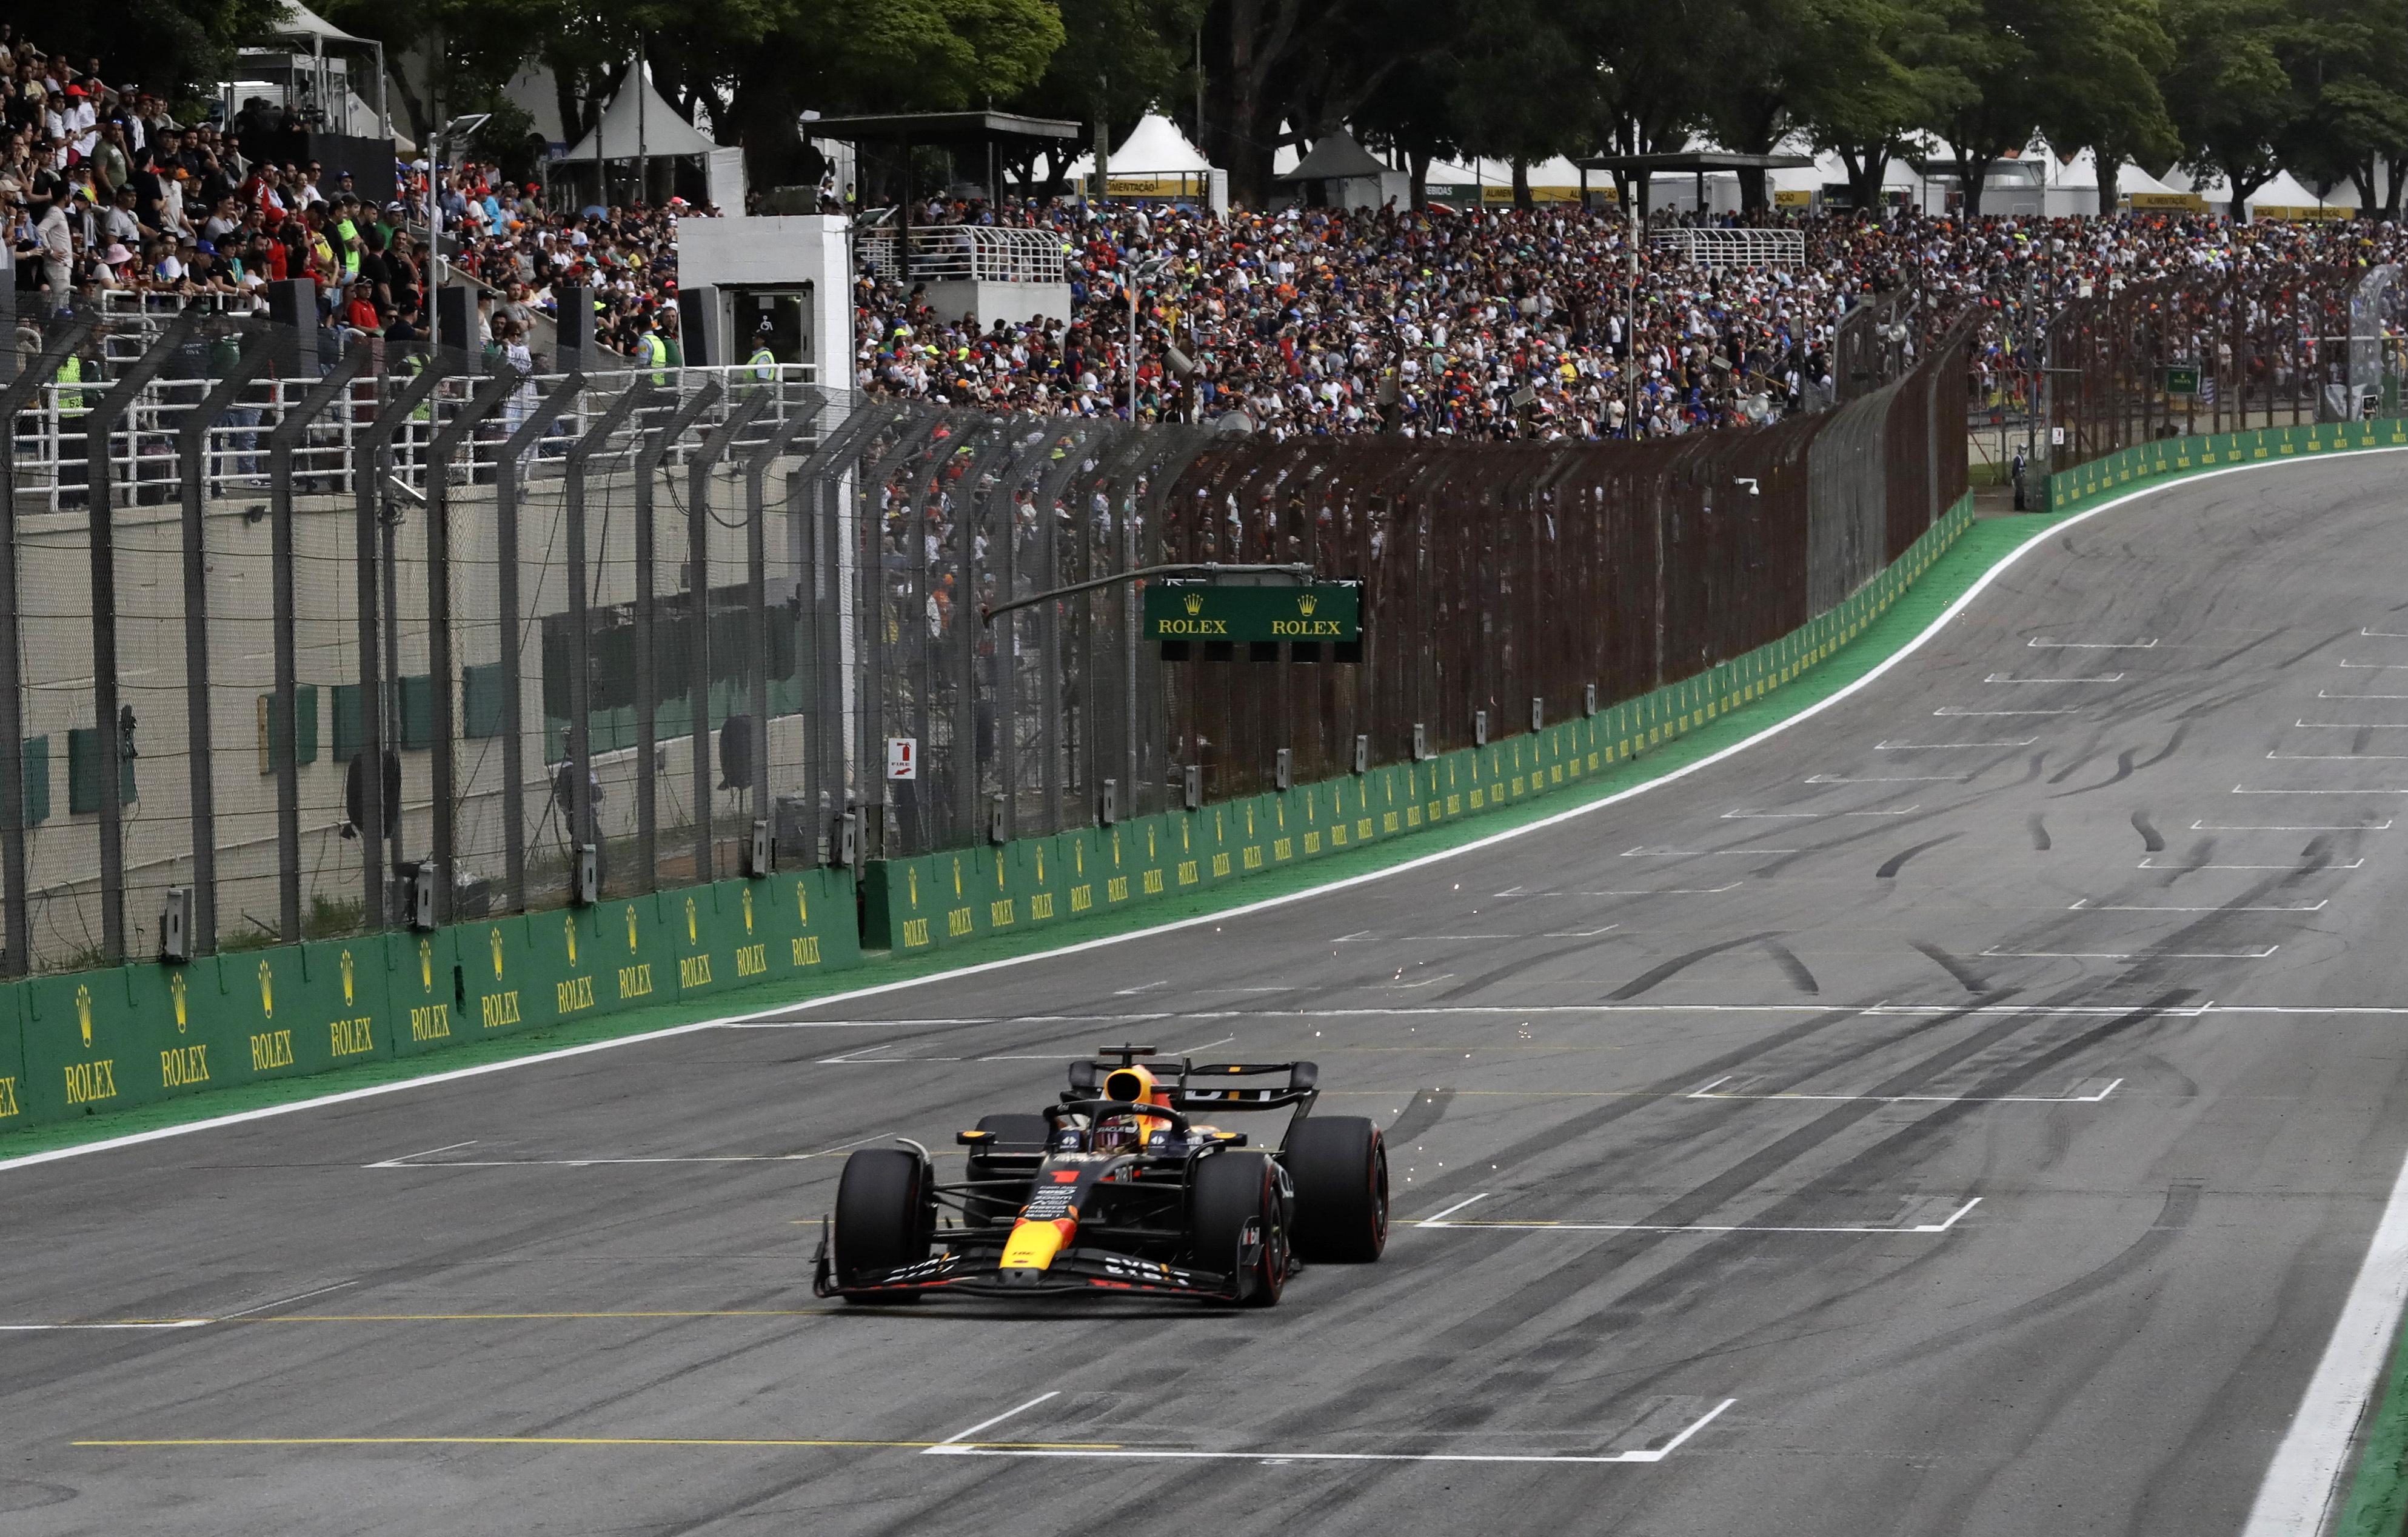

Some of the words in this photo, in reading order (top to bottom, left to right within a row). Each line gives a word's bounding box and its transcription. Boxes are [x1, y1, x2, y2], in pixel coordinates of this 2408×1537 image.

[1159, 619, 1227, 634] ROLEX
[1272, 621, 1341, 635] ROLEX
[991, 899, 1014, 927] ROLEX
[1031, 893, 1054, 920] ROLEX
[1071, 884, 1092, 912] ROLEX
[903, 918, 929, 947] ROLEX
[948, 907, 972, 937] ROLEX
[736, 944, 767, 976] ROLEX
[791, 936, 821, 966] ROLEX
[618, 964, 653, 999] ROLEX
[680, 954, 712, 989] ROLEX
[481, 990, 521, 1028] ROLEX
[557, 976, 595, 1013] ROLEX
[330, 1017, 374, 1056] ROLEX
[410, 1004, 450, 1041] ROLEX
[160, 1044, 210, 1087] ROLEX
[250, 1029, 294, 1071] ROLEX
[64, 1059, 117, 1104] ROLEX
[1049, 1170, 1080, 1182] 1
